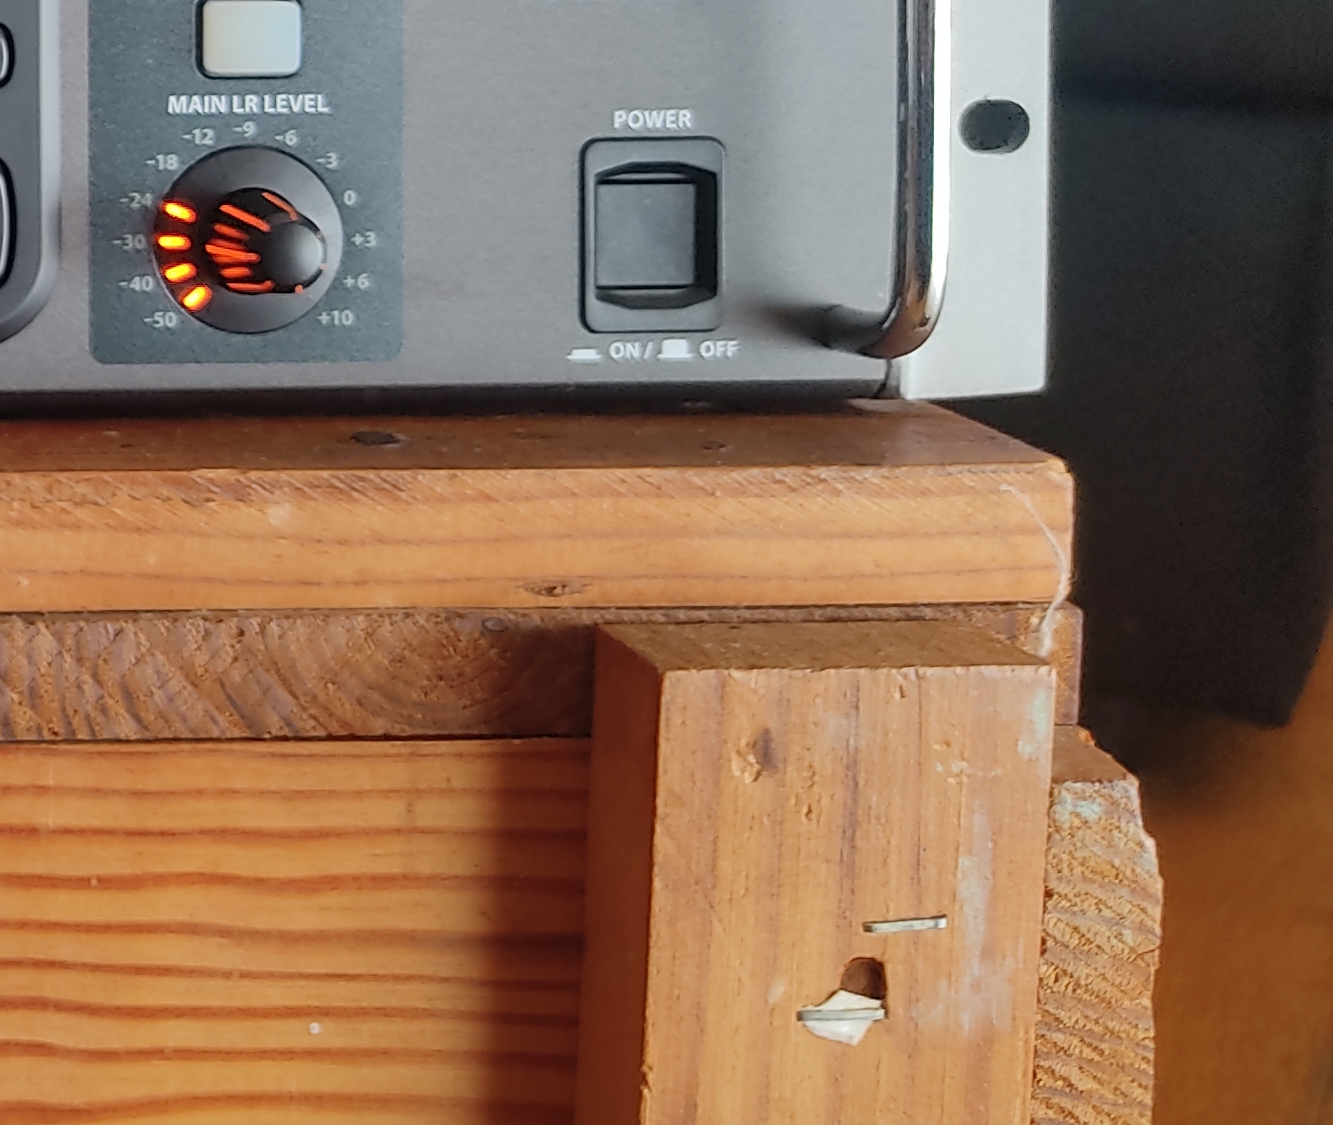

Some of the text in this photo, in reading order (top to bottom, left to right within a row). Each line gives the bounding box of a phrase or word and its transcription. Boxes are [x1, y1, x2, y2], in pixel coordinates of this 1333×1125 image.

[167, 94, 329, 115] MAIN LR LEVEL
[613, 109, 693, 130] POWER
[182, 129, 214, 145] -12
[233, 122, 256, 137] -9
[275, 130, 298, 145] -6
[146, 154, 179, 170] -18
[316, 153, 338, 169] -3
[351, 231, 377, 247] +3
[118, 276, 153, 292] -40
[343, 274, 370, 290] +6
[143, 312, 177, 327] -50
[317, 310, 353, 326] +10
[608, 341, 641, 360] ON
[699, 340, 740, 358] OFF
